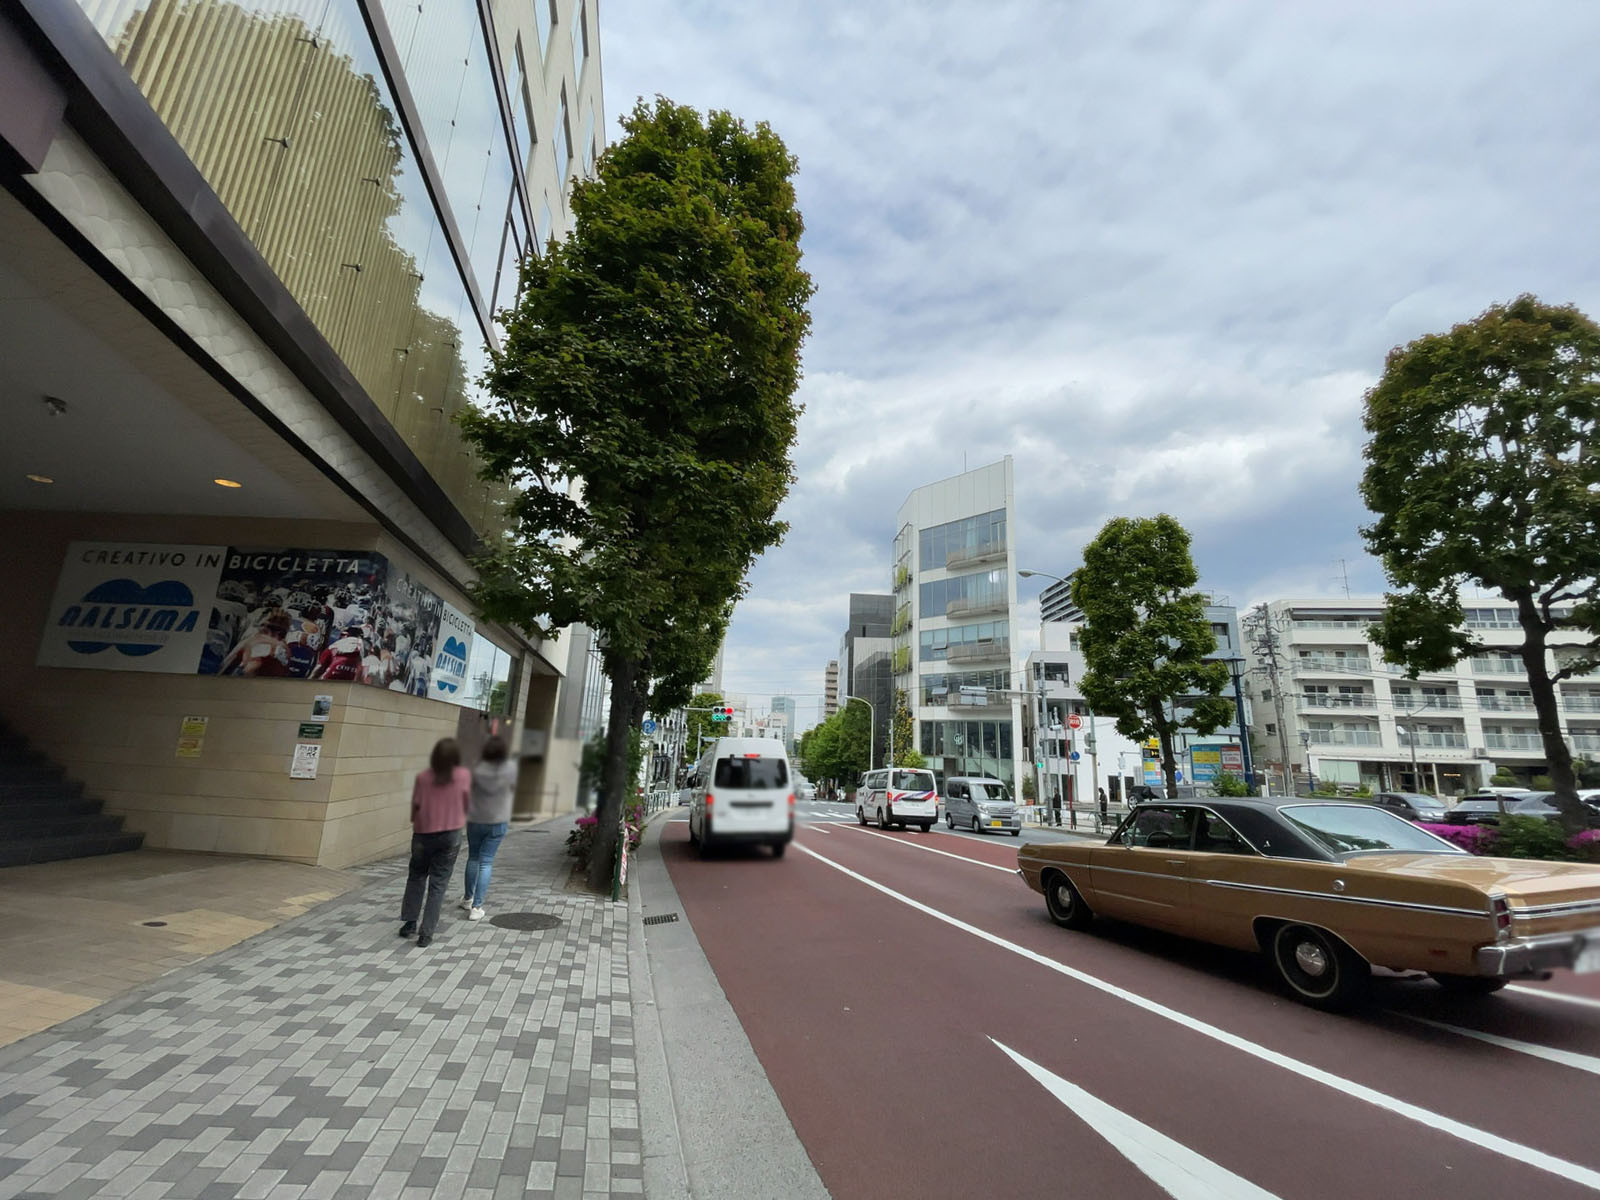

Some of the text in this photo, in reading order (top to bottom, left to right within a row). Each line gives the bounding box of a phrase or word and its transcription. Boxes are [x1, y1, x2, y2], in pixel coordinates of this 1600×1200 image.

[81, 550, 360, 574] CREATIVO IN BICICLETTA
[443, 609, 472, 635] BICICLETTA
